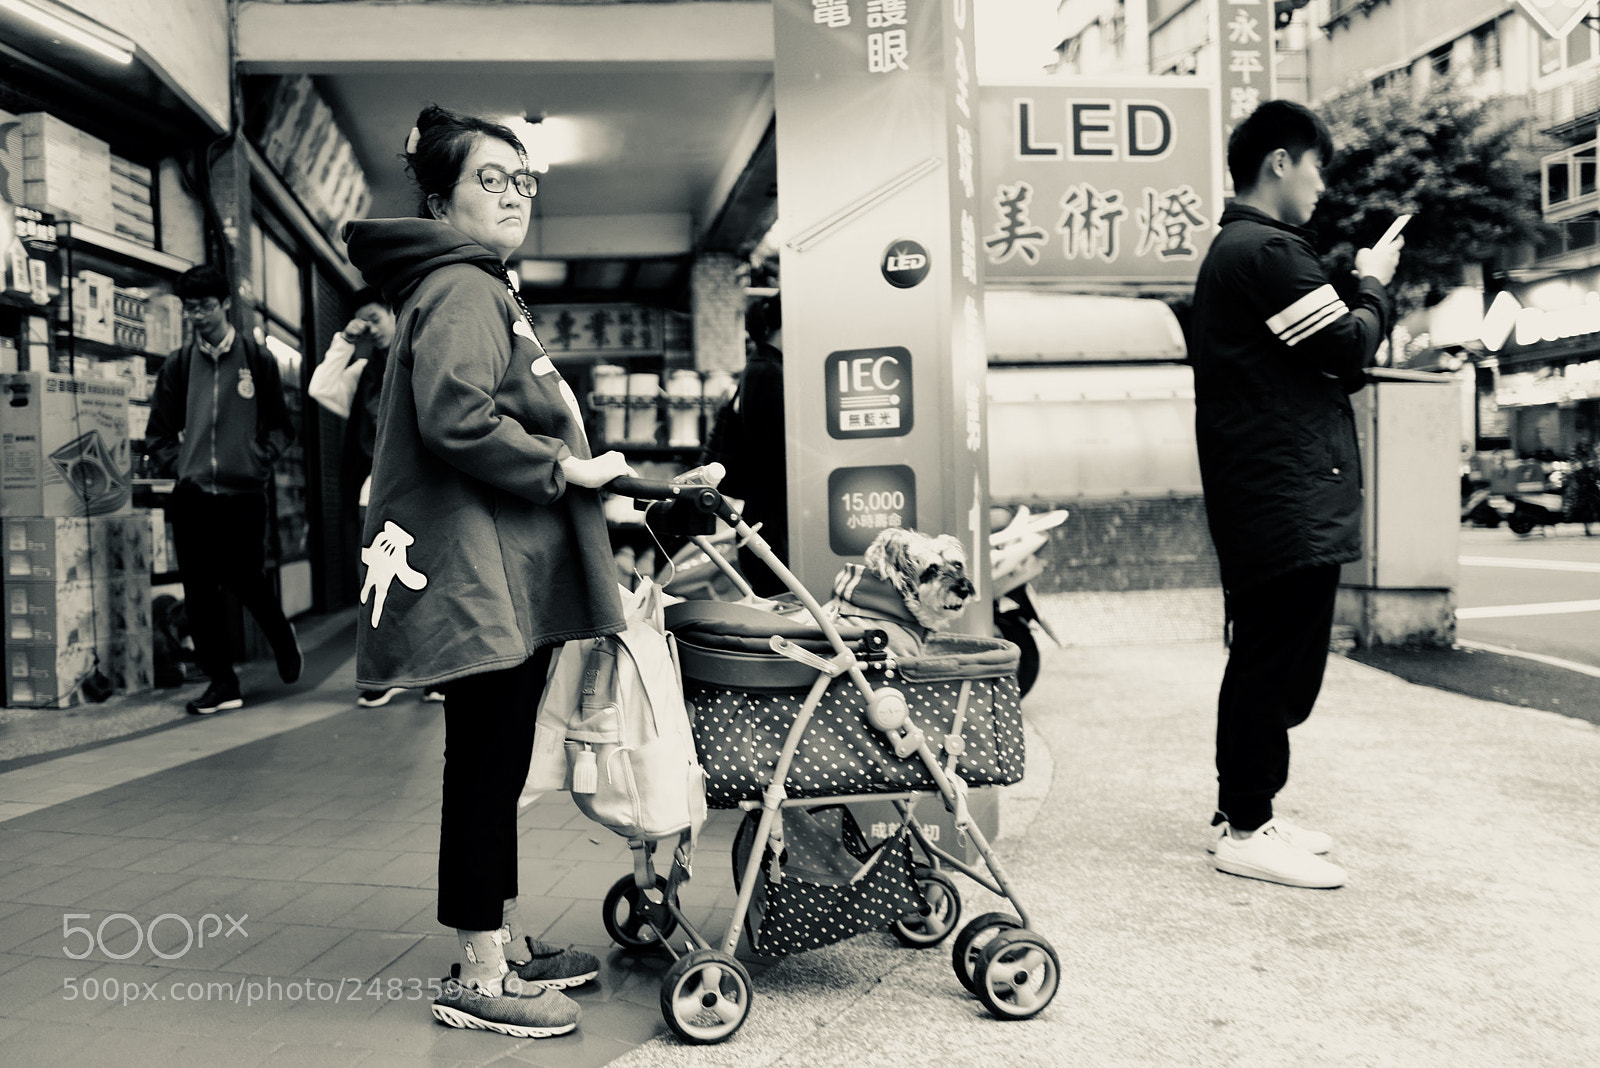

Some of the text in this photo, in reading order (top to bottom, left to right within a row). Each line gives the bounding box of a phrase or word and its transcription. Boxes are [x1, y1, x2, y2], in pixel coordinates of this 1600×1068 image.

[866, 0, 909, 73] 護眼
[1017, 101, 1174, 158] LED
[985, 183, 1206, 262] 美術燈
[887, 253, 926, 272] LED
[838, 356, 900, 392] IEC
[841, 491, 904, 513] 15,000
